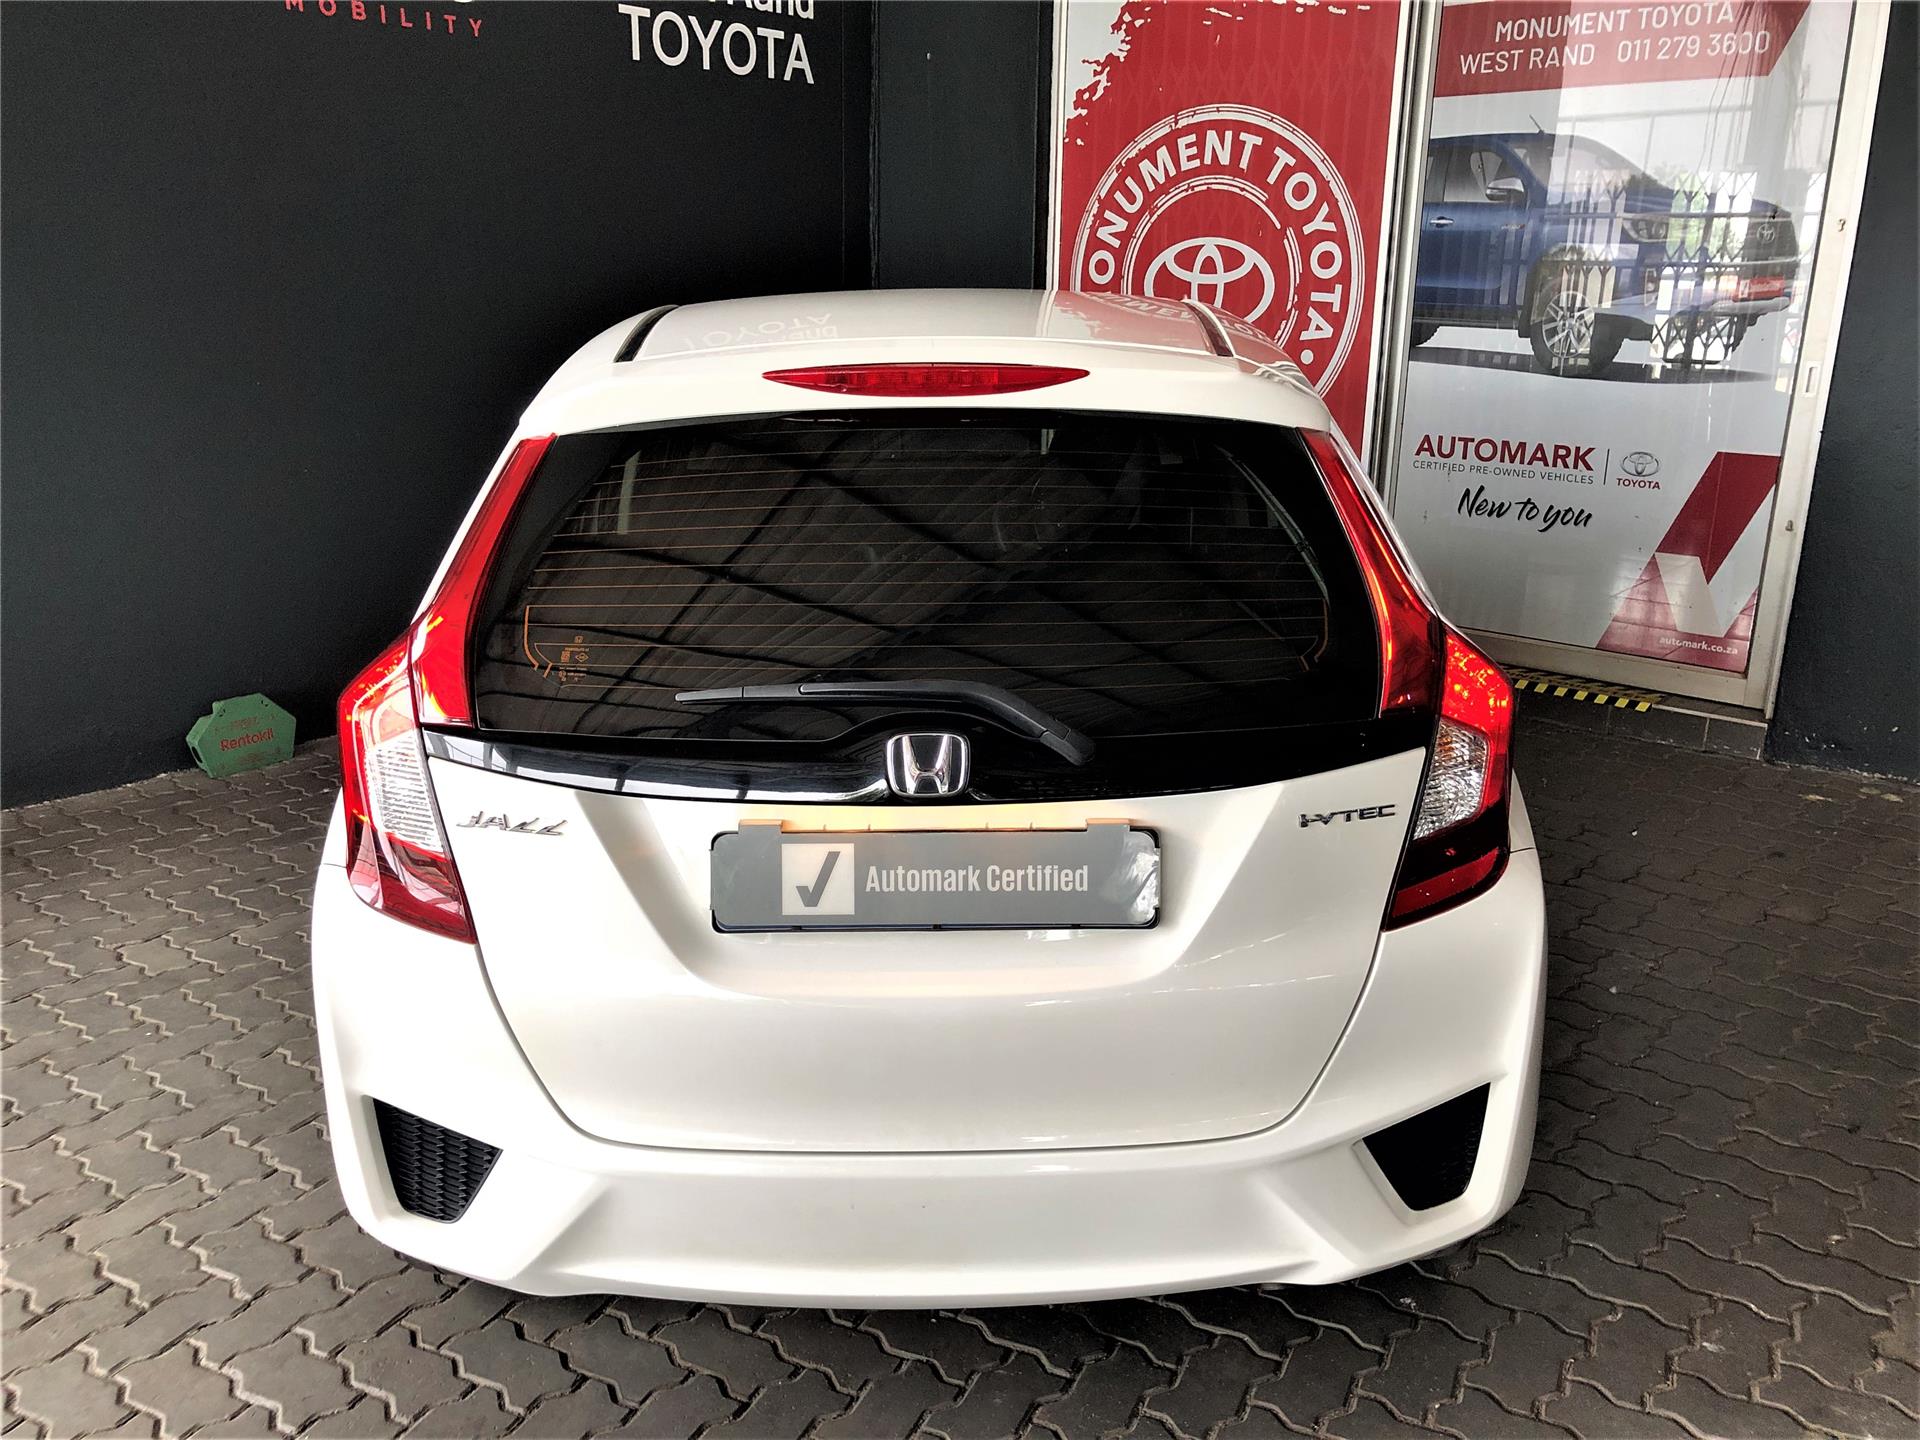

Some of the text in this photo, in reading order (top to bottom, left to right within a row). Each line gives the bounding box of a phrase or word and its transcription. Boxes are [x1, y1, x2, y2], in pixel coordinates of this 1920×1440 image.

[284, 0, 482, 37] MOBILITY
[1495, 1, 1734, 43] MONUMENT TOYOTA
[618, 3, 815, 85] TOYOTA
[1460, 51, 1523, 75] WEST
[1529, 44, 1595, 69] RAND
[1617, 40, 1650, 63] 011
[1656, 35, 1700, 60] 279
[1088, 130, 1263, 285] ONUMENT
[1415, 434, 1596, 471] AUTOMARK
[1412, 460, 1594, 485] CERTIFIED PRE-OWNED VEHICLES
[1616, 477, 1661, 490] TOYOTA
[1458, 485, 1593, 533] New to you
[1659, 636, 1738, 655] automark.co.za
[219, 728, 274, 751] Rentokil
[865, 864, 1089, 893] Automark Certified
